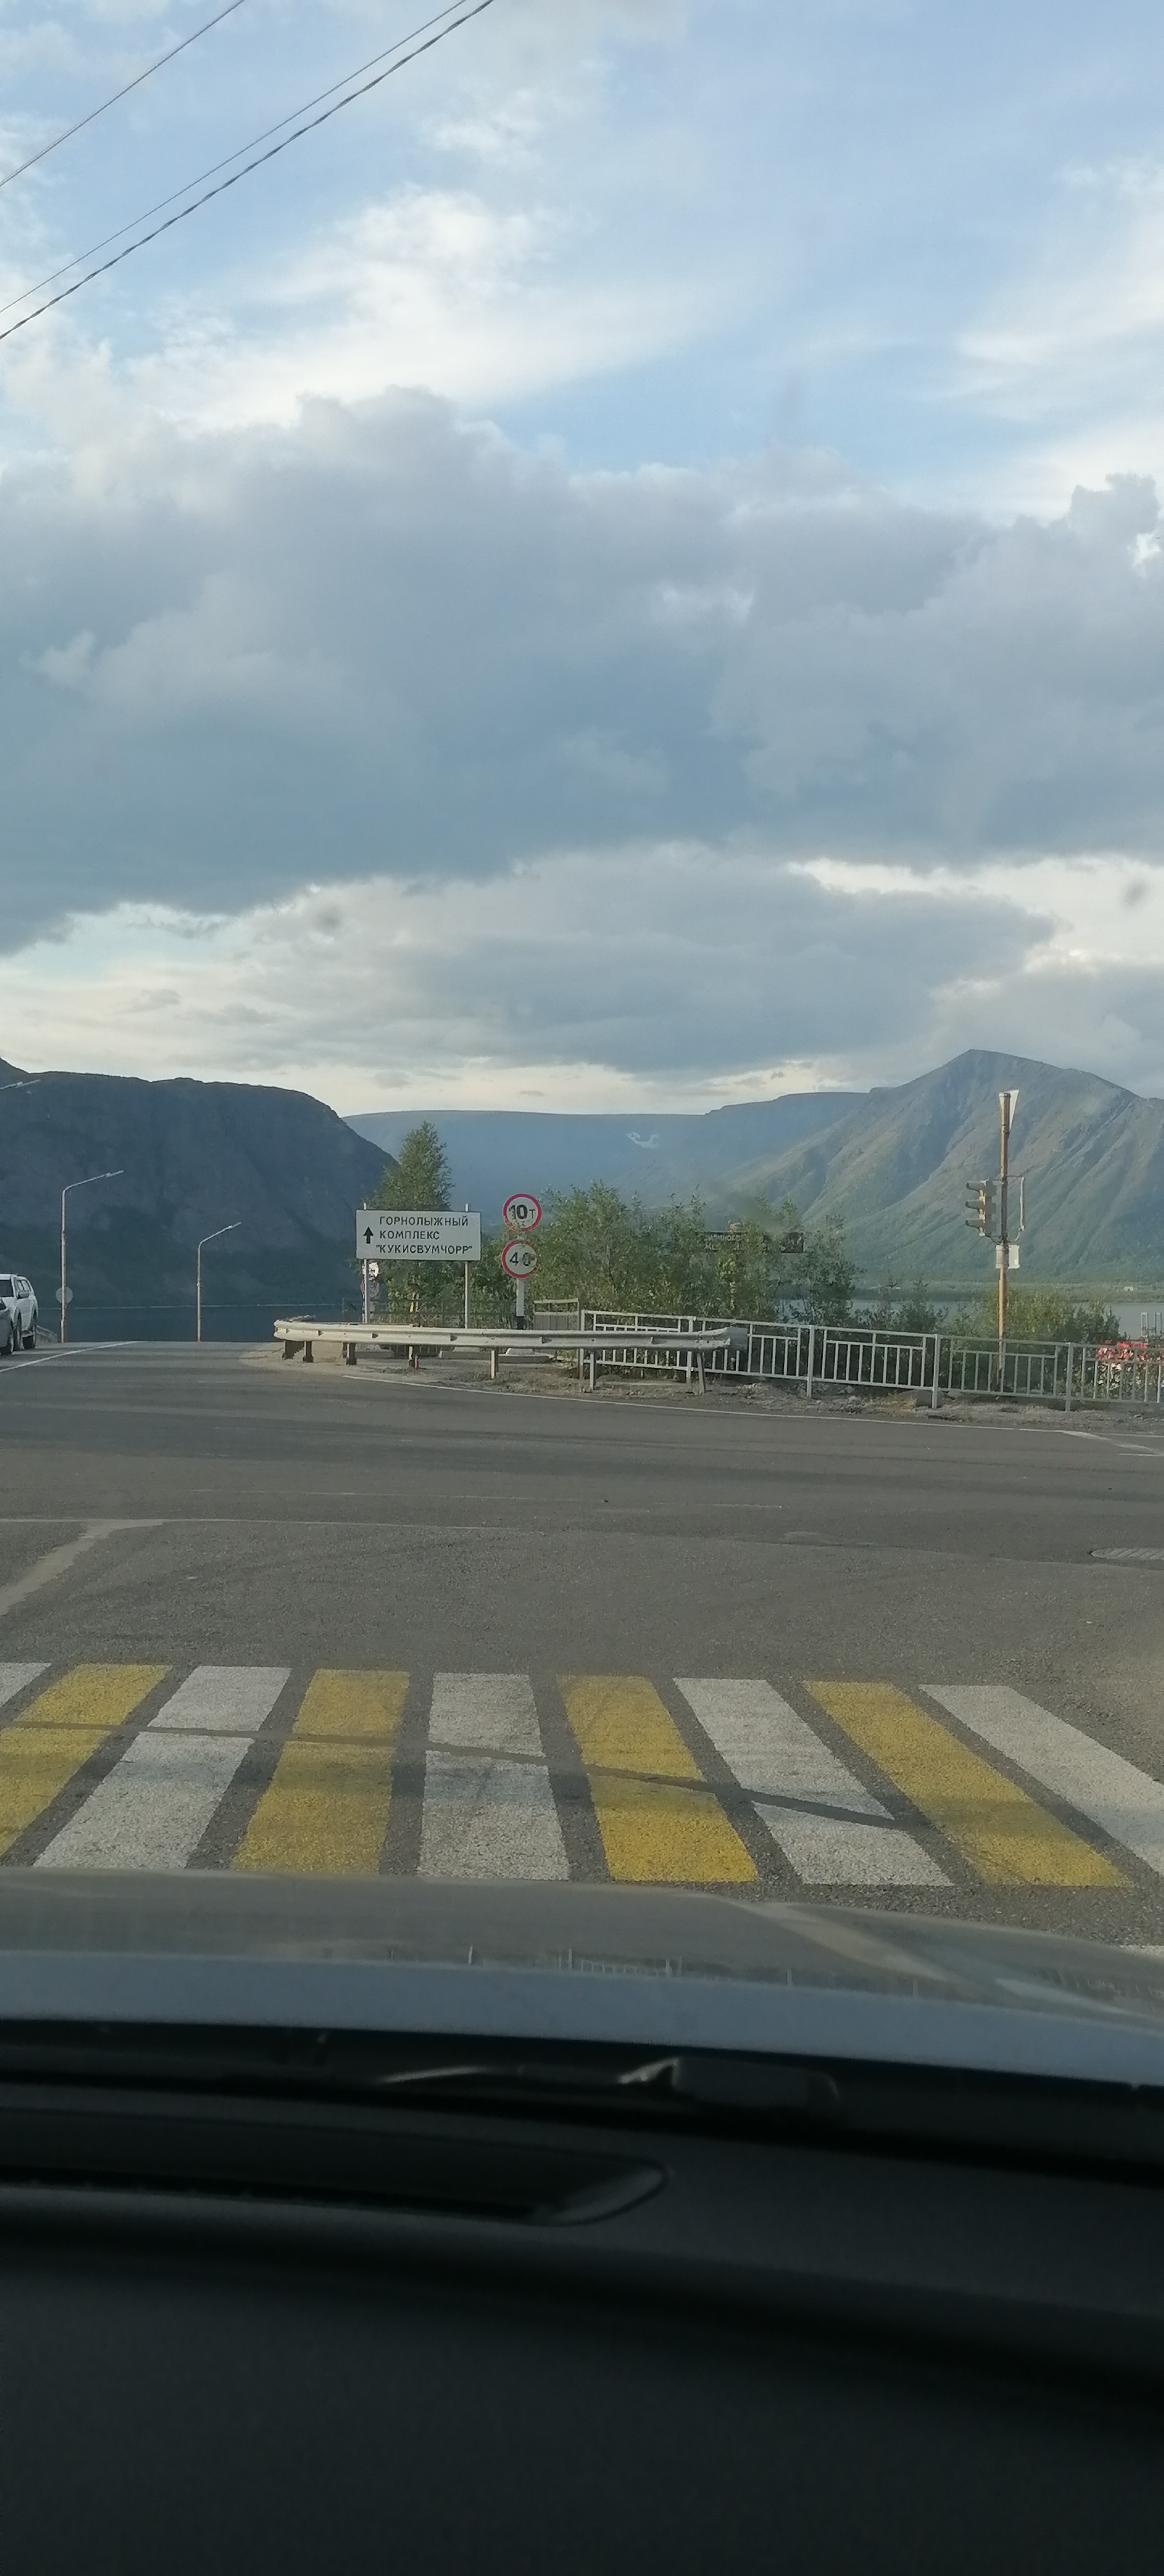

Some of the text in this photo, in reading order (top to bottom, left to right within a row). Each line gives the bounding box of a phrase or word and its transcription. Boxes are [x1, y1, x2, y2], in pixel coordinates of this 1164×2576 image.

[379, 1215, 469, 1226] ГОРНОЛЫЖНЫЙ
[379, 1230, 440, 1240] КОМПЛЕКС
[376, 1244, 473, 1254] "КУКИСВУМЧОРР"
